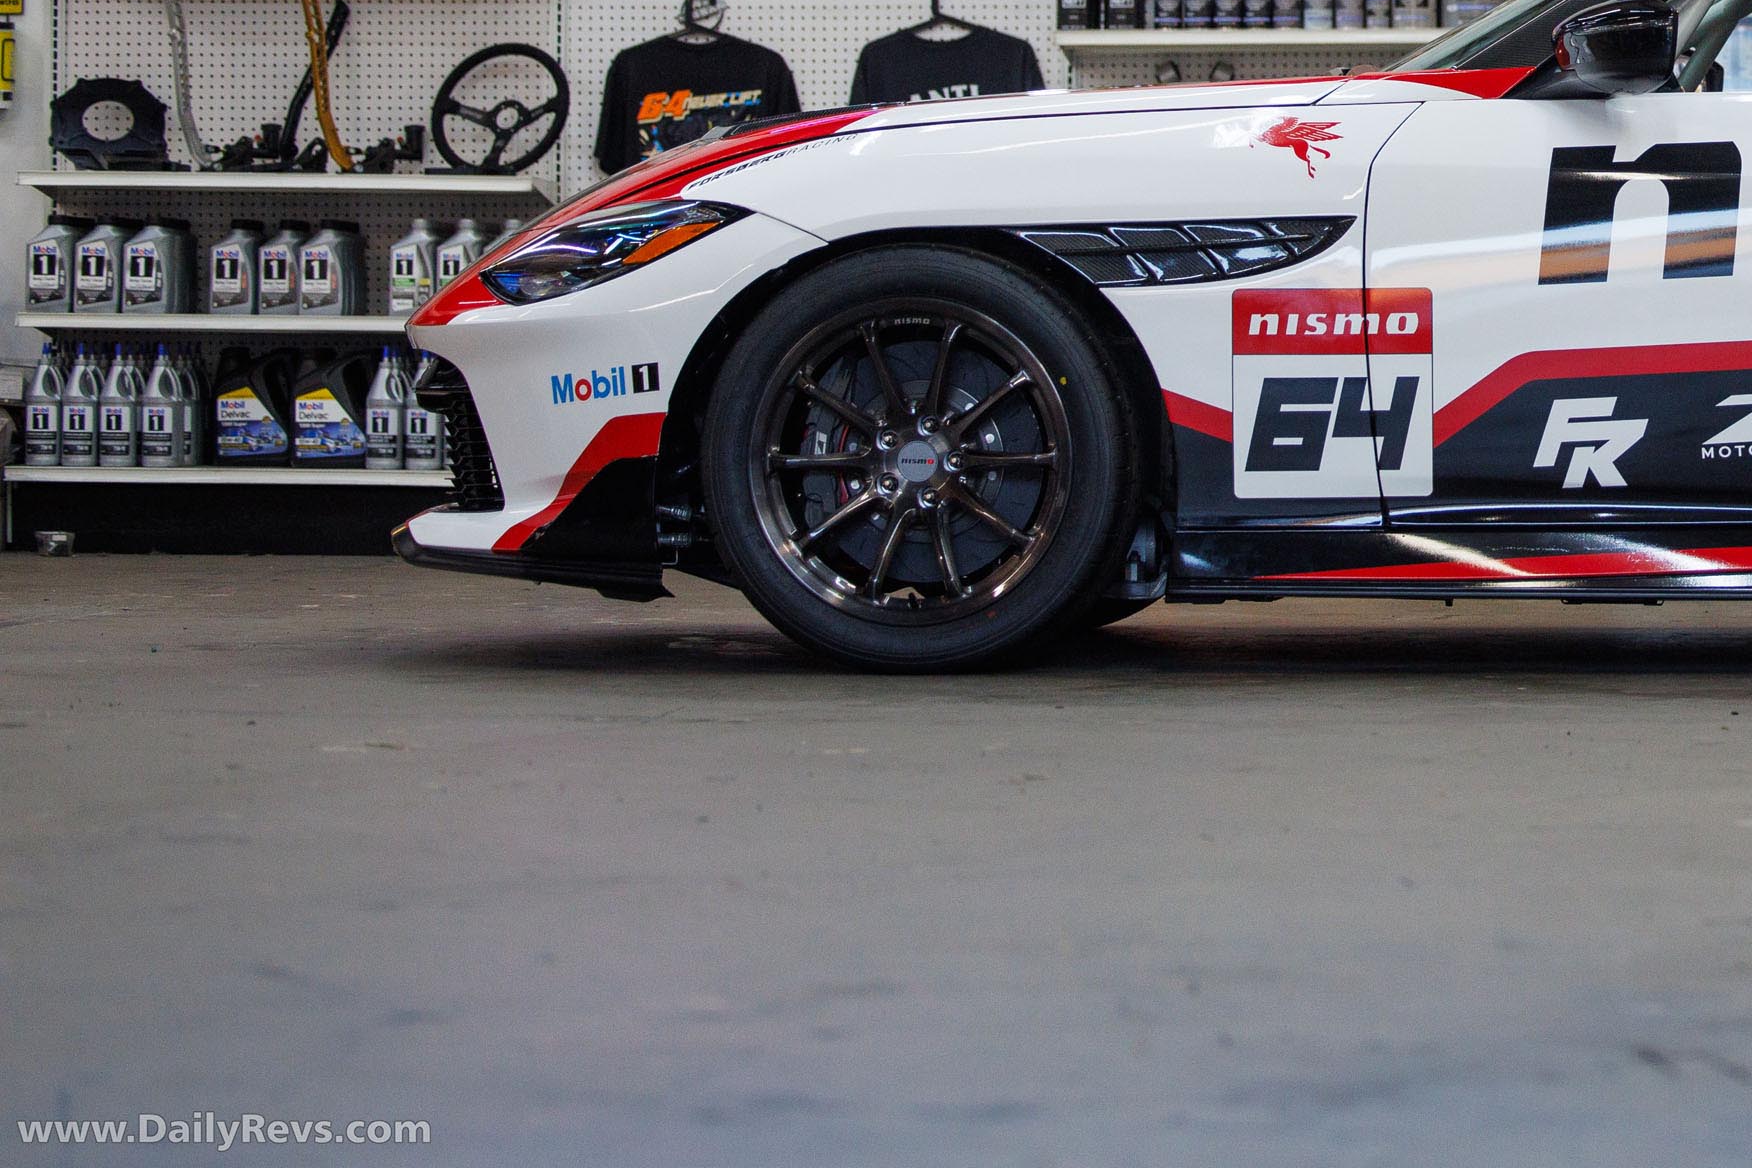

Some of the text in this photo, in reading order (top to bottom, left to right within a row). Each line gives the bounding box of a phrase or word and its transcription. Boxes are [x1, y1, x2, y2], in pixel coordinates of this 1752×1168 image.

[636, 89, 692, 124] 64
[784, 132, 859, 156] RACING
[894, 317, 931, 326] nismo
[1248, 312, 1420, 336] nismo
[551, 366, 626, 405] Mobil
[220, 400, 246, 410] Mobil
[298, 402, 324, 411] Mobil
[220, 410, 250, 419] Delvac
[299, 411, 328, 420] Delvac
[1245, 376, 1420, 472] 64
